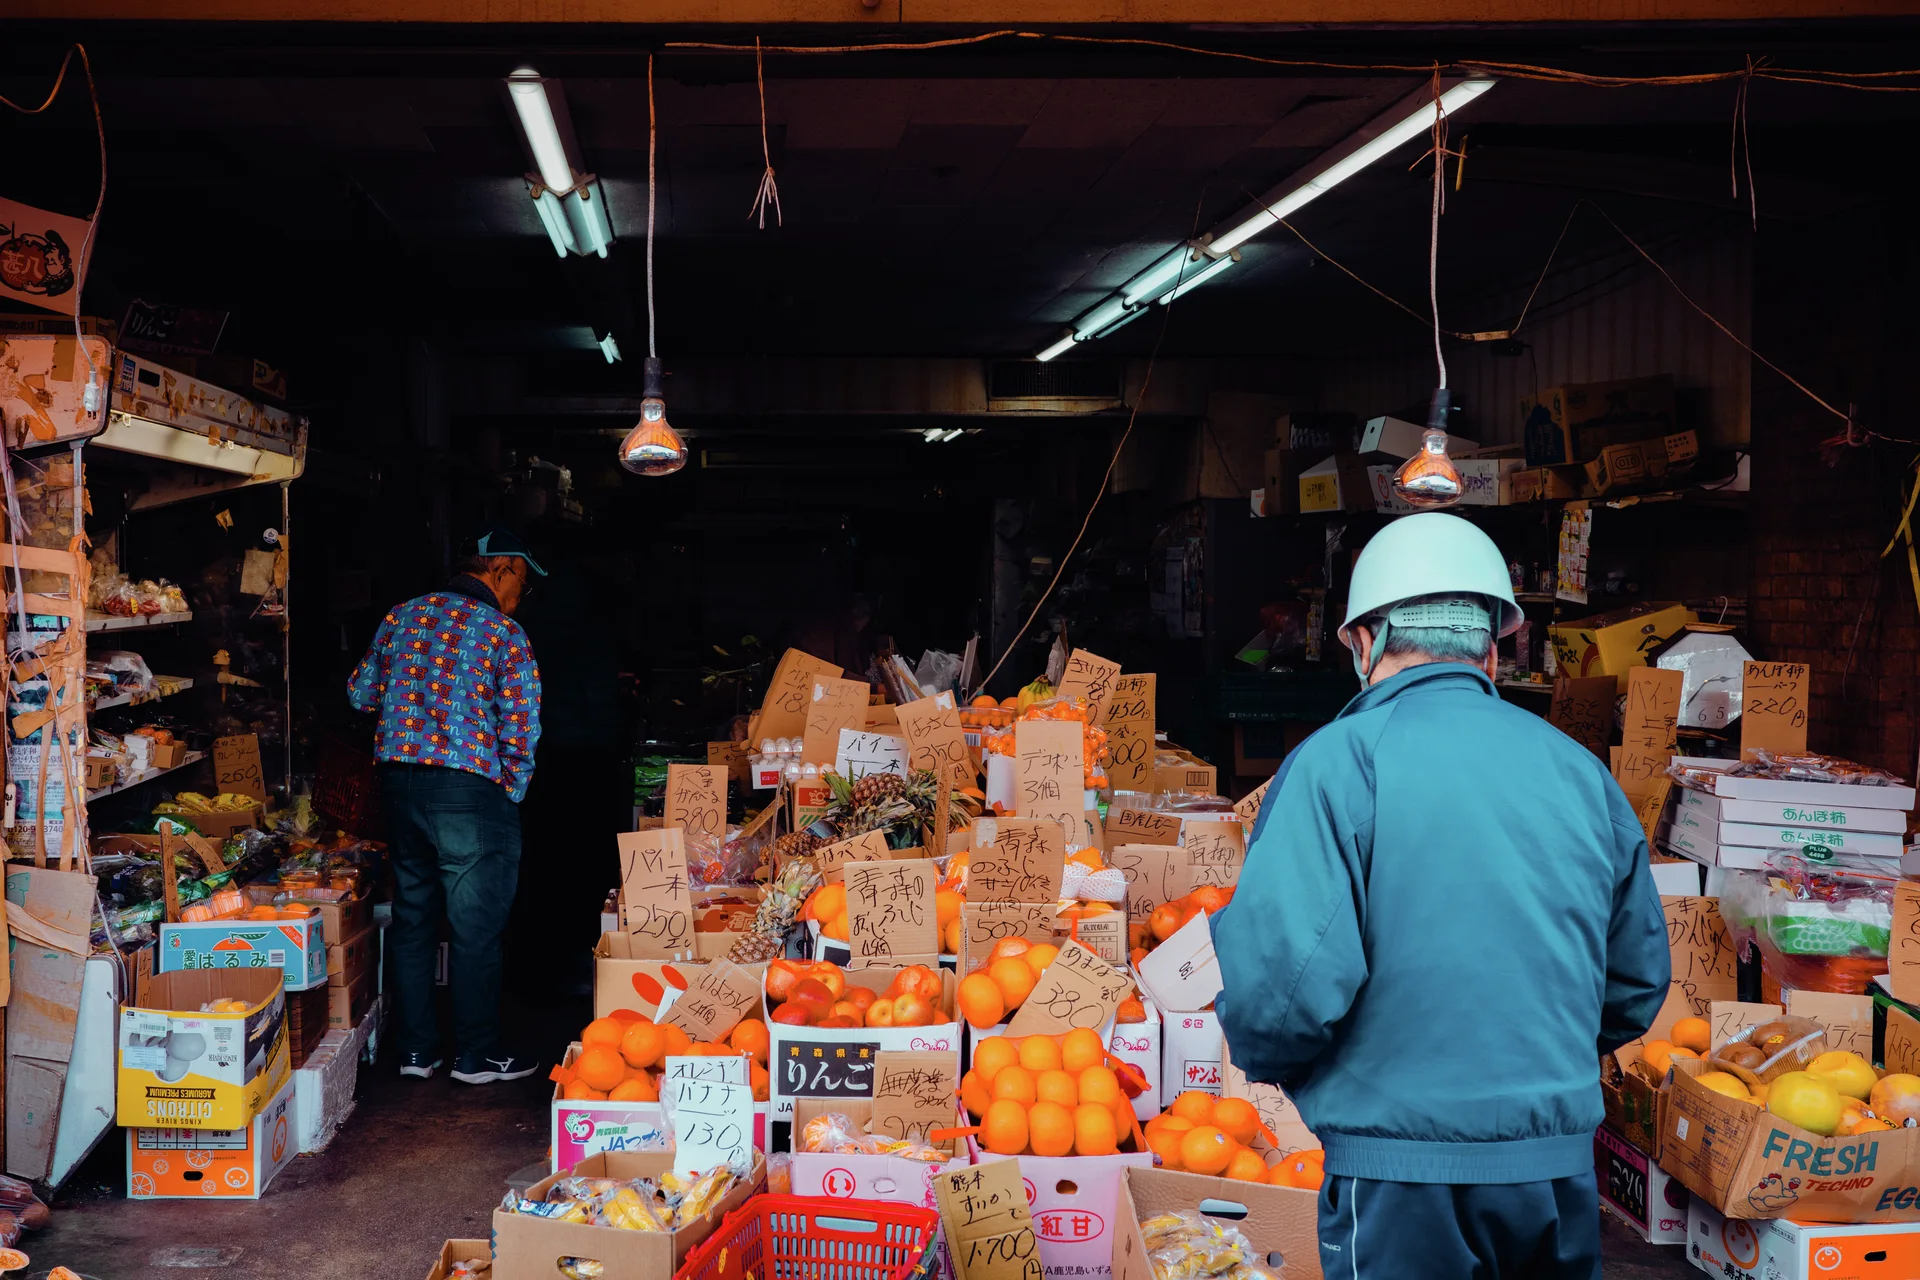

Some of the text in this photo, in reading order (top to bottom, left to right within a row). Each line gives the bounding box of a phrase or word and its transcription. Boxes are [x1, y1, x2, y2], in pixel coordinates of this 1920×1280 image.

[847, 734, 901, 754] パイン
[1782, 808, 1846, 825] あんぽ柿
[1780, 831, 1844, 847] あんぽ柿
[631, 904, 687, 939] 250
[199, 952, 268, 968] はるみ
[1031, 982, 1105, 1030] 380
[790, 1046, 869, 1059] 青森県産
[787, 1059, 875, 1093] りんご
[149, 1087, 212, 1099] AGRUMES PREMIUM
[678, 1080, 737, 1104] バナナ
[147, 1099, 212, 1118] CITRONS
[778, 1102, 793, 1113] JA
[595, 1126, 629, 1137] 青森県産
[683, 1121, 743, 1151] 130
[1762, 1128, 1879, 1177] FRESH
[951, 1170, 985, 1194] 熊本
[1805, 1177, 1874, 1192] TECHNO
[1875, 1187, 1920, 1212] EG
[1041, 1215, 1091, 1237] 紅甘
[1043, 1265, 1112, 1276] A鹿児島いずみ
